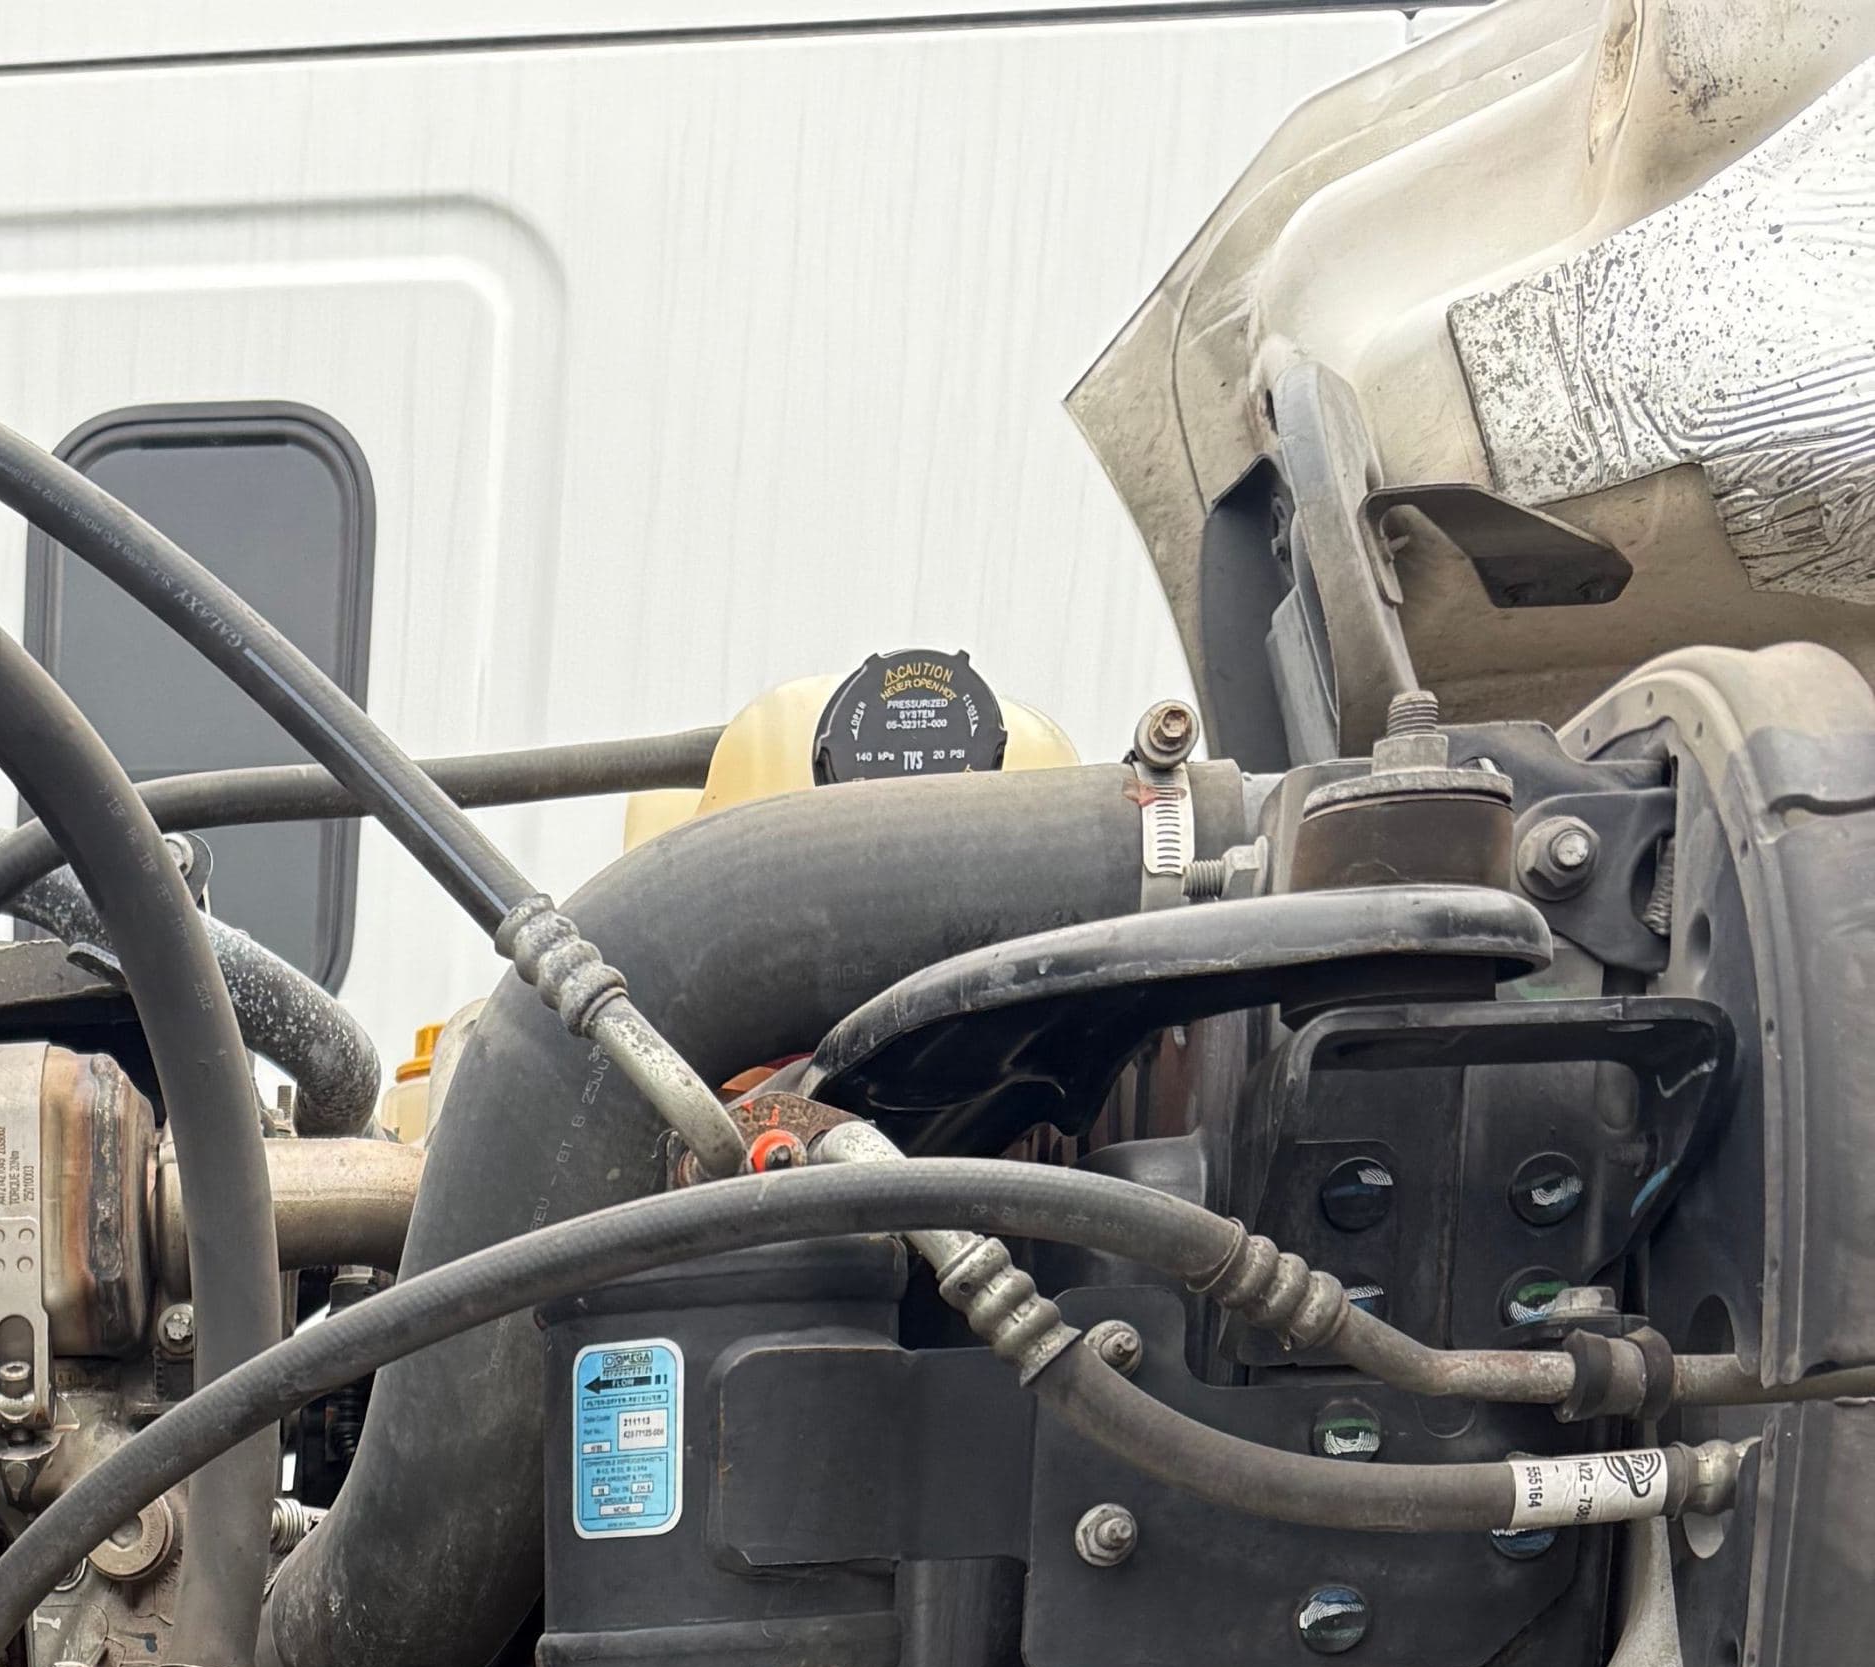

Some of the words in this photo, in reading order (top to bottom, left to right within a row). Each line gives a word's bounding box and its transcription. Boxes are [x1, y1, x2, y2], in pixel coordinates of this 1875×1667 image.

[173, 589, 246, 648] GALAXY
[896, 662, 954, 683] CAUTION
[881, 679, 912, 700] NEVER
[914, 680, 940, 692] OPEN
[940, 683, 958, 701] HOT
[887, 698, 948, 709] PRESSURIZED
[899, 710, 935, 719] SYSTEM
[856, 753, 872, 762] 140
[878, 752, 895, 761] kPa
[903, 751, 923, 771] TVS
[933, 750, 945, 759] 20
[950, 749, 965, 759] PSI
[10, 1173, 20, 1205] TORQUE
[612, 1379, 635, 1387] FLOW
